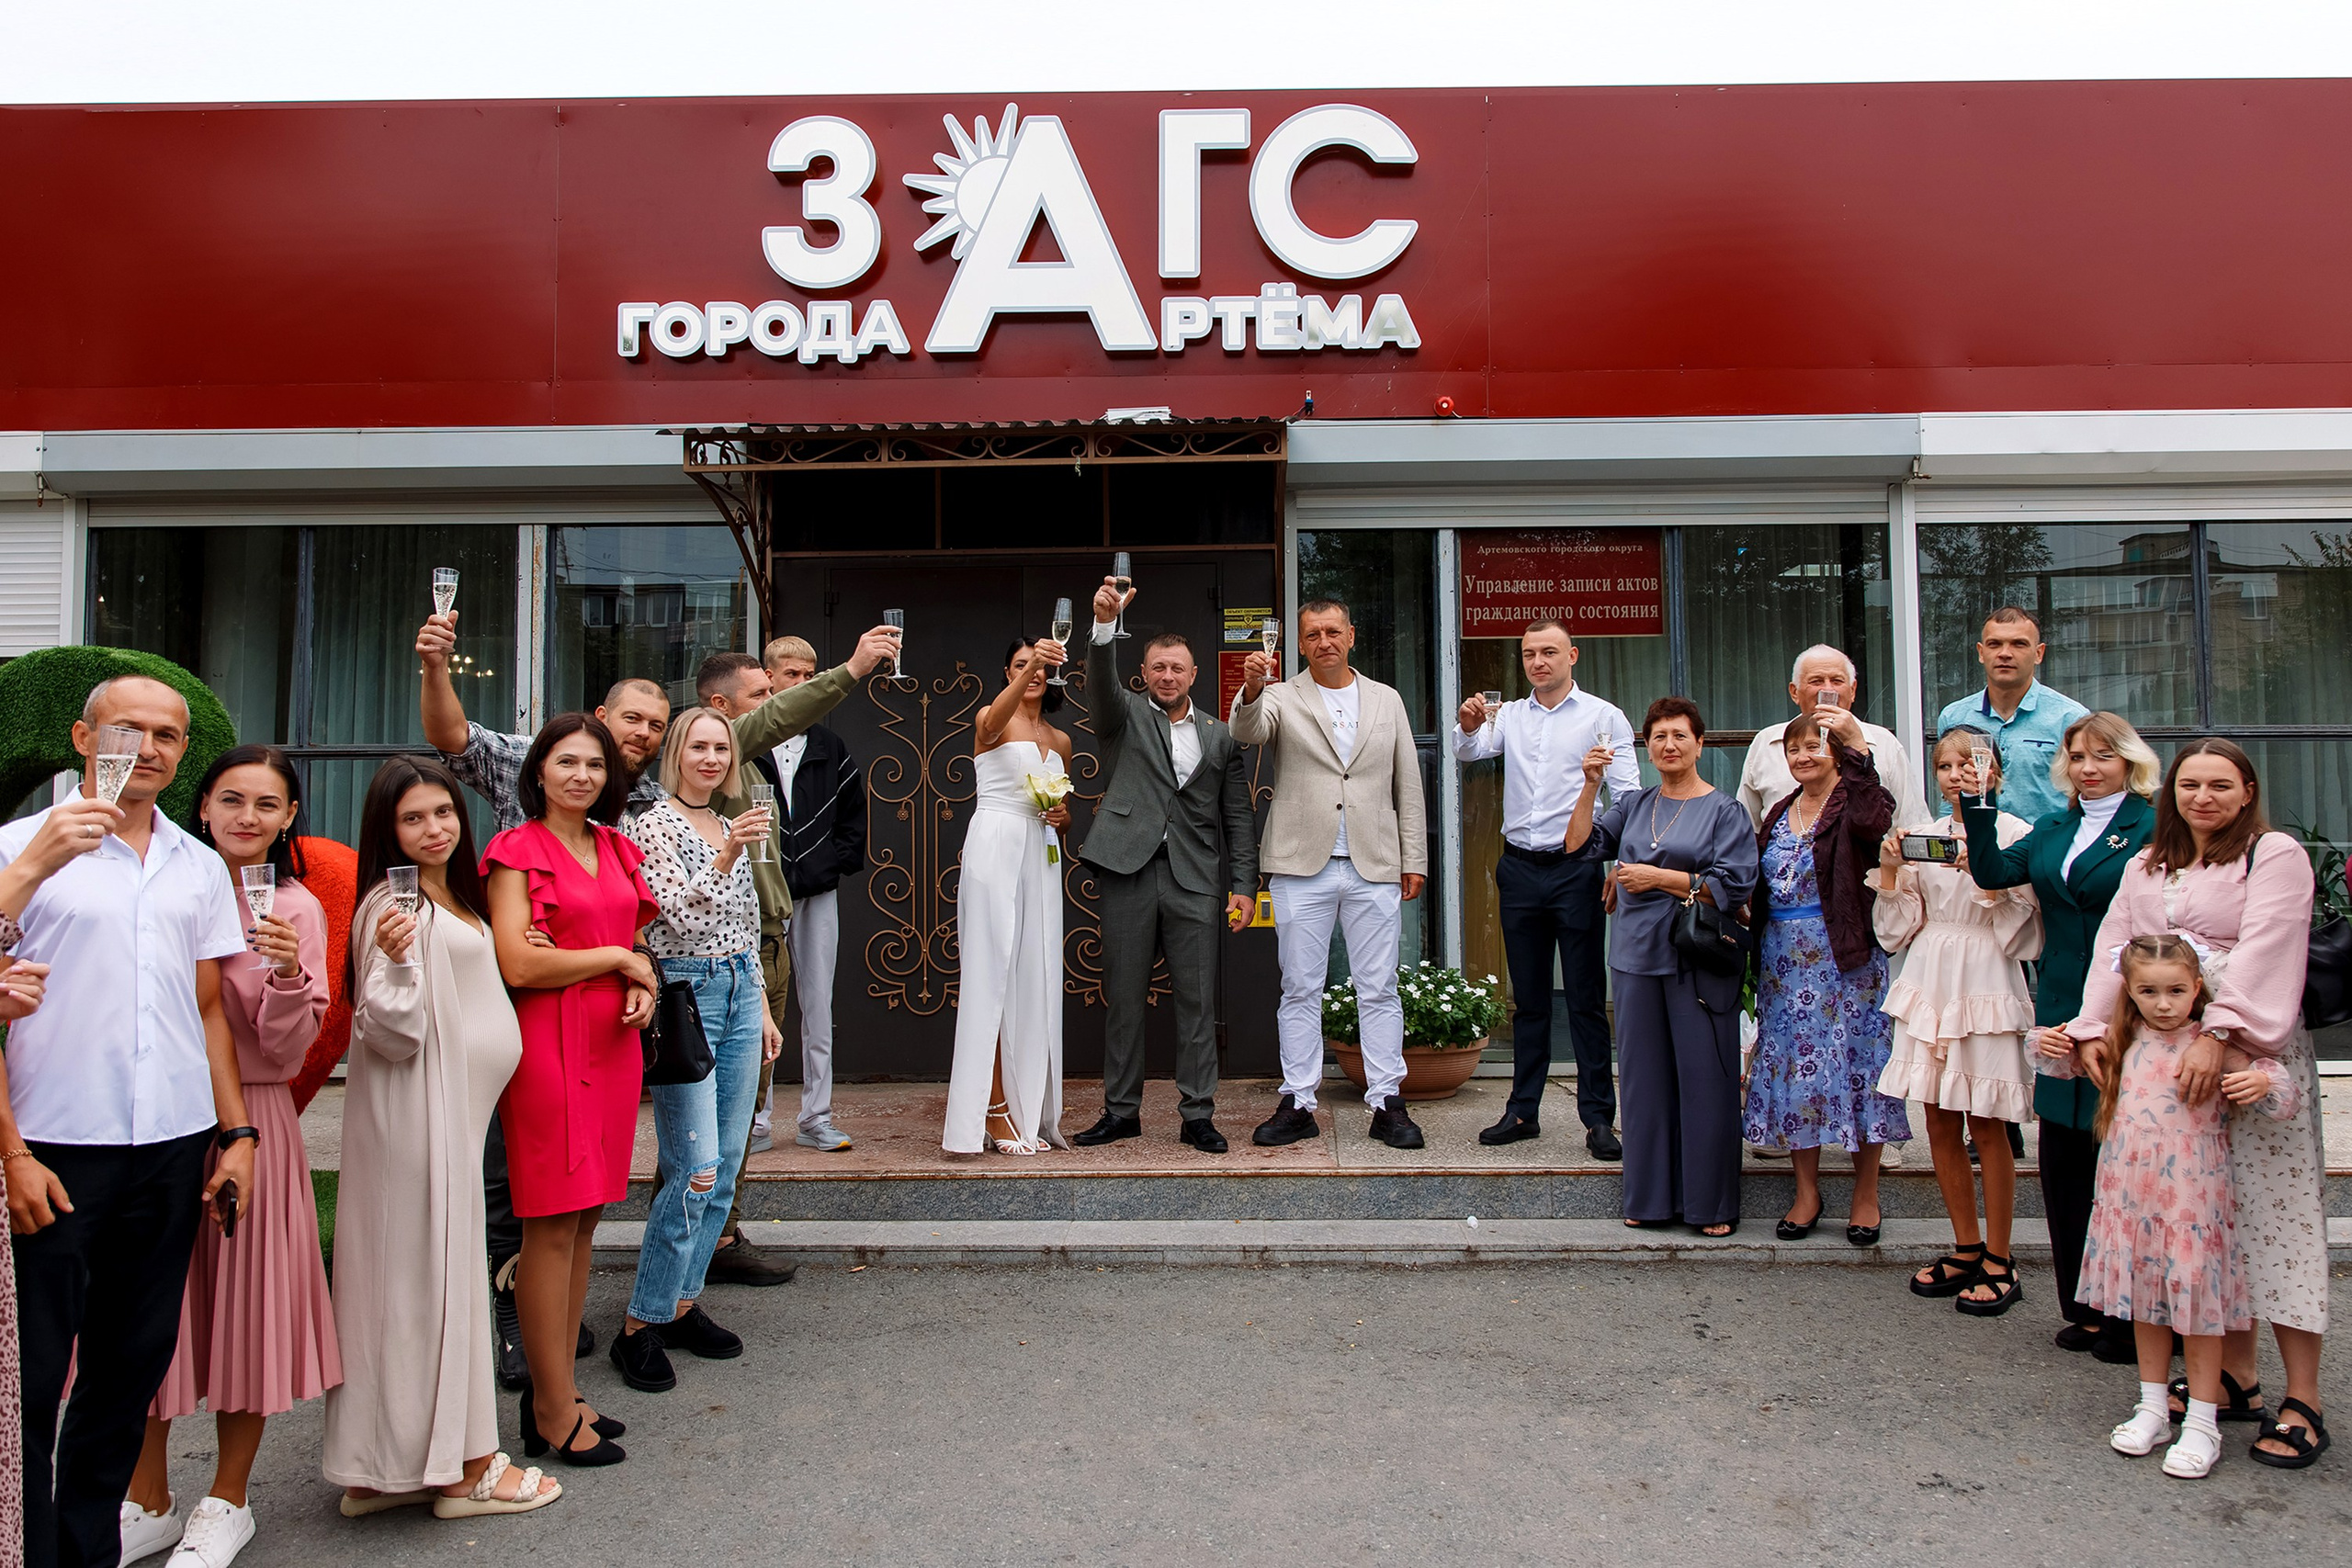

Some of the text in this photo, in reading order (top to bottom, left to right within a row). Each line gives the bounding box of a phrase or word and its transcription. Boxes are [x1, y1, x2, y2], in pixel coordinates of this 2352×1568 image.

[762, 103, 1419, 353] ЗАГС
[617, 299, 910, 363] ГОРОДА
[1477, 544, 1643, 556] Артемовского городского округа
[1465, 575, 1658, 599] Управление записи актов
[1466, 604, 1658, 626] гражданского состояния
